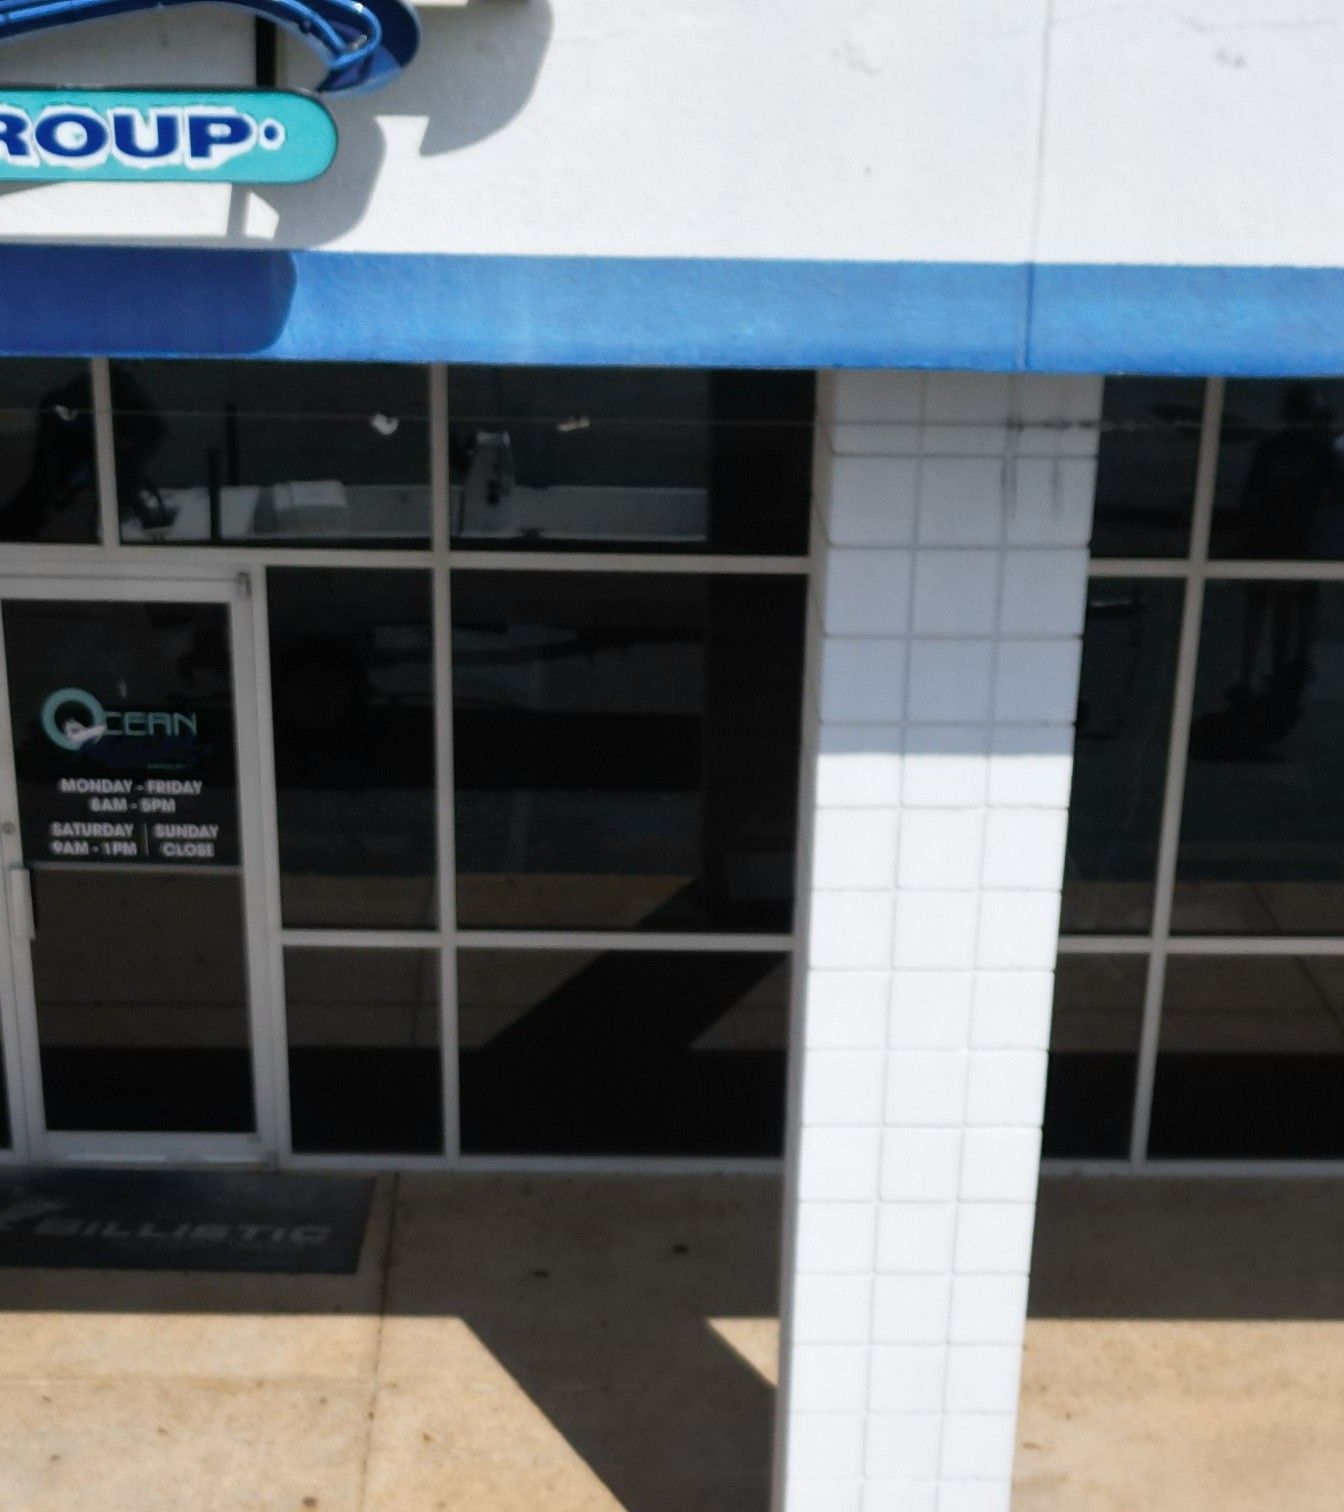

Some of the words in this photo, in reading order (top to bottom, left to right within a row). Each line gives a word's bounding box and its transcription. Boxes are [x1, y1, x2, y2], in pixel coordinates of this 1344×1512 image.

[60, 778, 133, 794] MONDAY
[147, 780, 203, 795] FRIDAY
[50, 822, 134, 838] SATURDAY
[154, 824, 219, 839] SUNDAY
